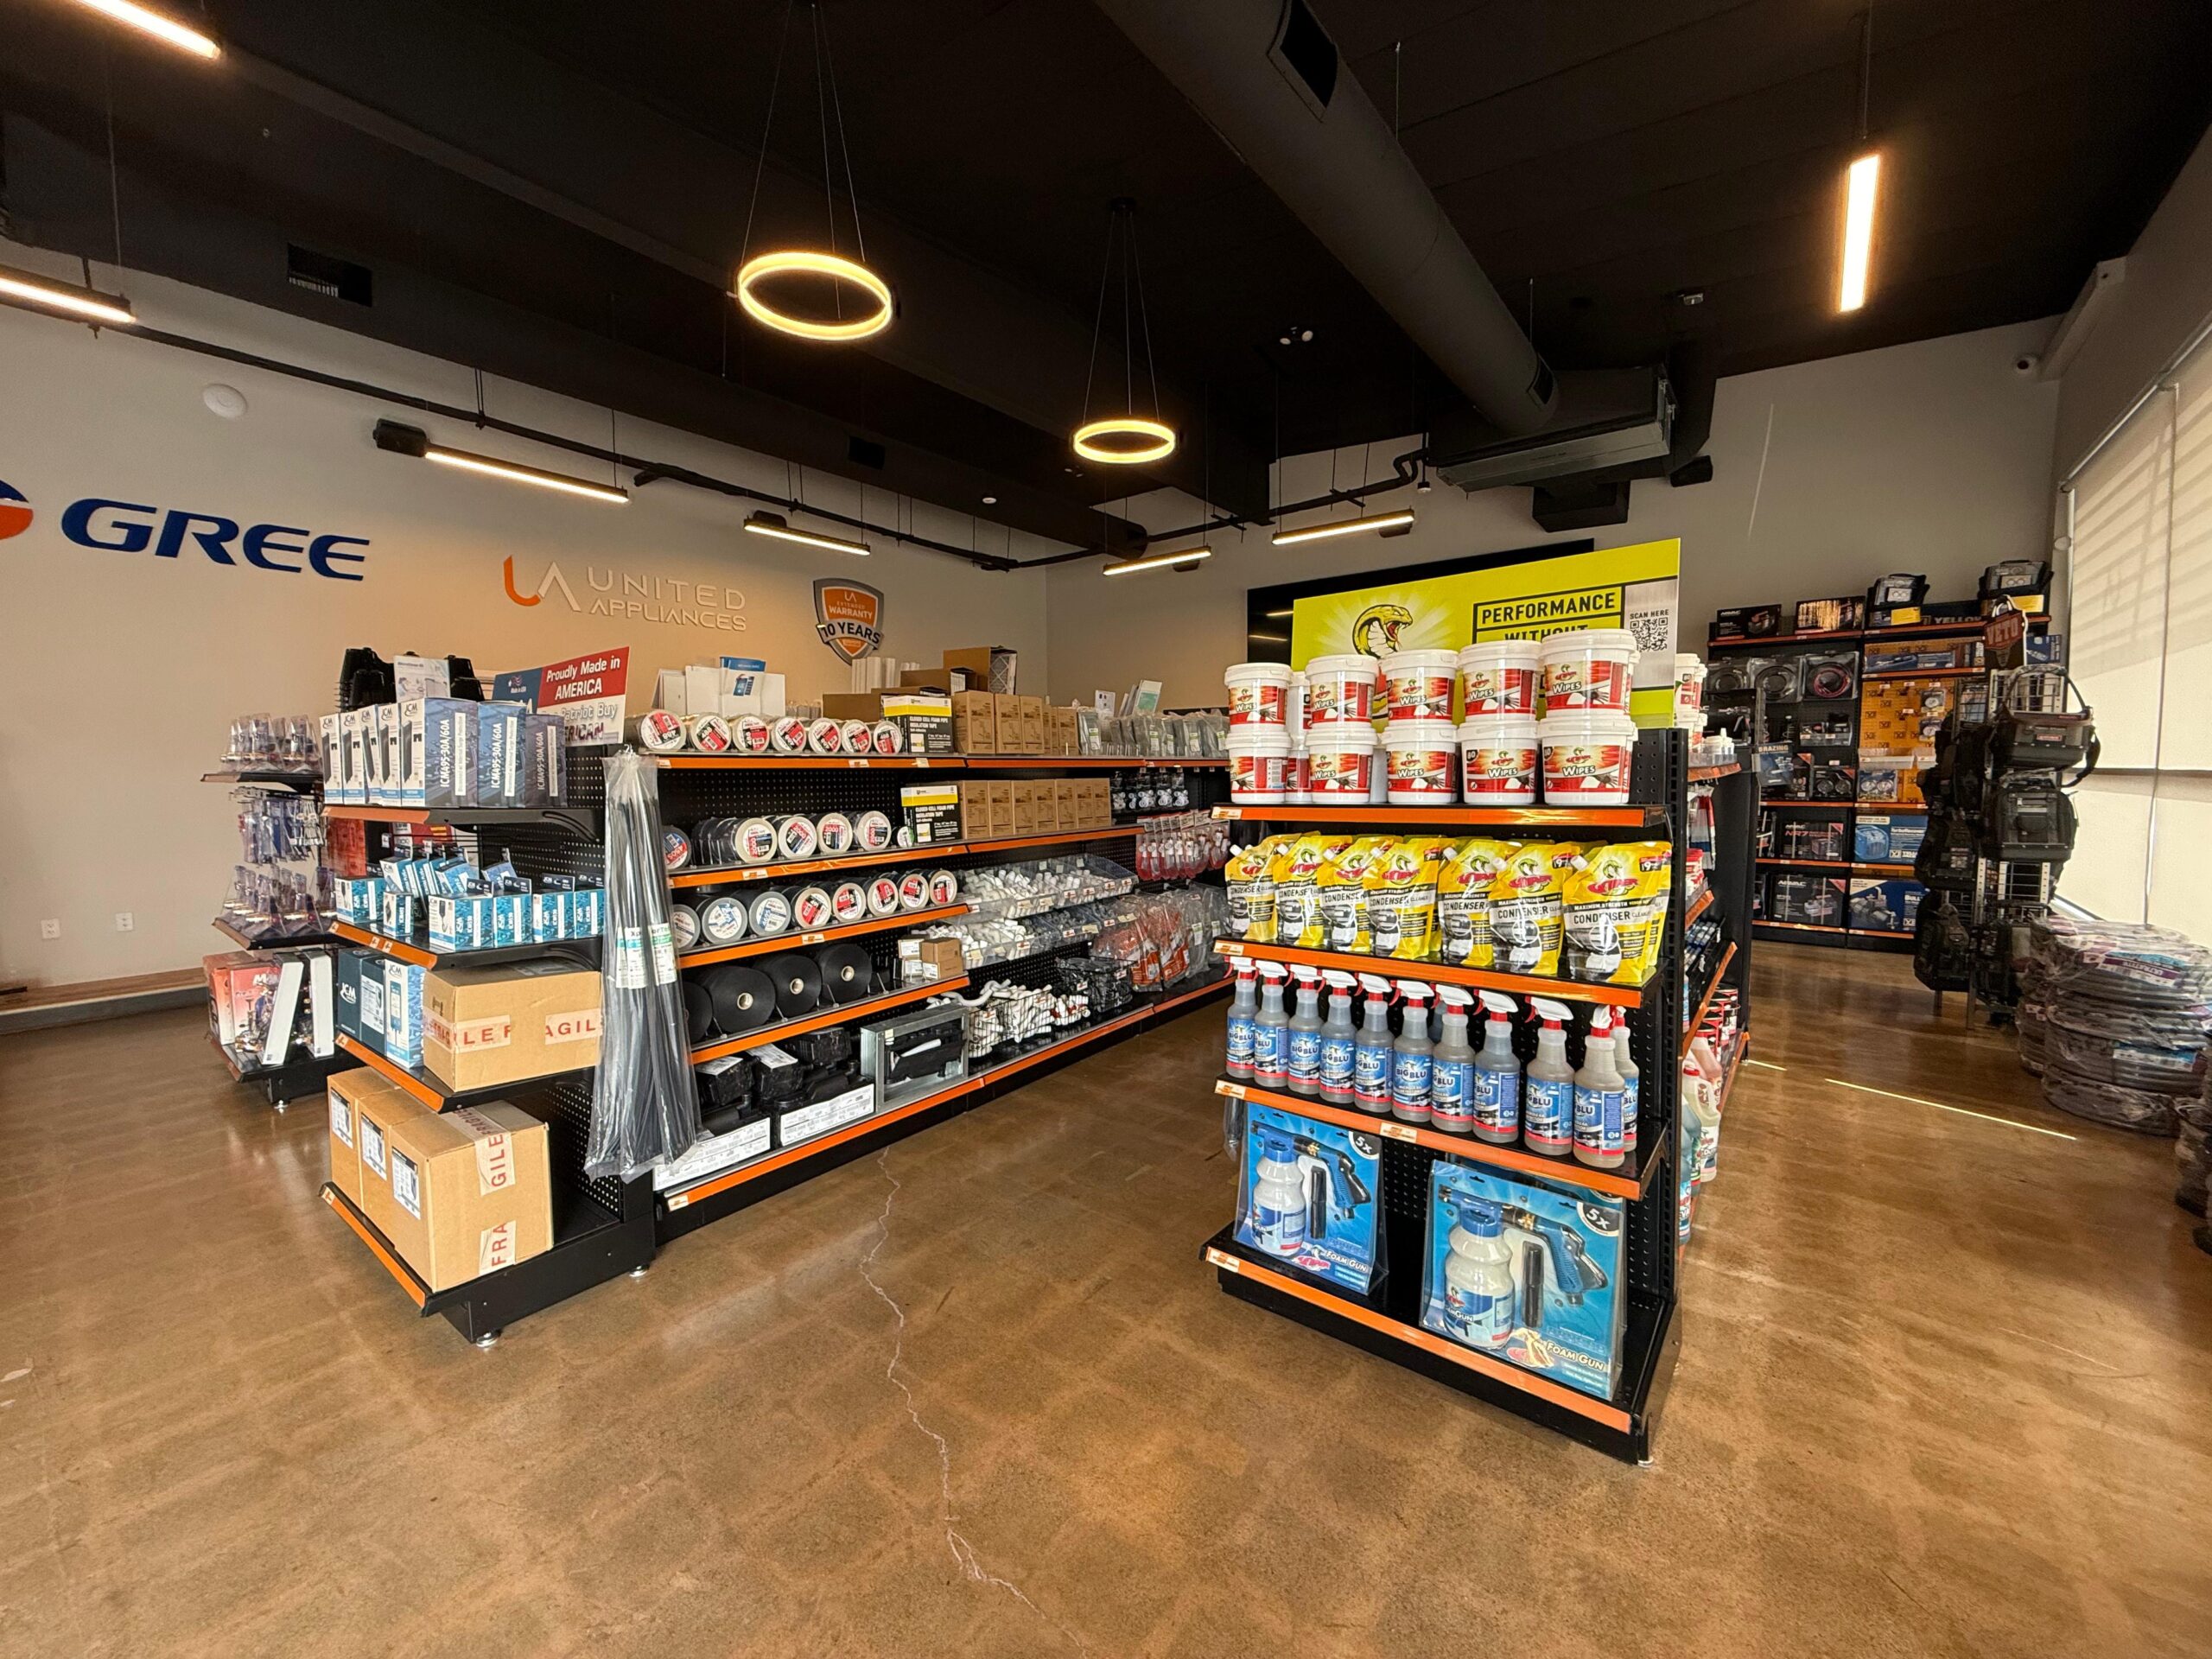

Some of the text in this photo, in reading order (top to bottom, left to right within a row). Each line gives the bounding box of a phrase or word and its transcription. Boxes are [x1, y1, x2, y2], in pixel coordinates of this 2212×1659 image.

[61, 498, 371, 582] GREE
[587, 565, 747, 612] UNITED
[589, 598, 747, 632] APPLIANCES
[829, 606, 873, 620] WARRANTY
[1482, 592, 1616, 625] PERFORMANCE
[1630, 608, 1669, 620] SCAN HERE
[821, 623, 836, 638] 10
[837, 622, 881, 645] YEARS
[1987, 617, 2018, 645] VETO
[546, 655, 620, 683] Proudly Made in
[555, 678, 602, 701] AMERICA
[1468, 688, 1494, 701] WIPES
[1553, 681, 1582, 694] WIPES
[597, 702, 618, 720] Buy
[1313, 699, 1334, 709] WIPES
[1400, 695, 1427, 706] WIPES
[563, 722, 605, 744] ERICAN
[439, 719, 450, 788] ICM495-30A/60A
[490, 722, 502, 789] ICM495-30A/60A
[1313, 769, 1337, 779] WIPES
[1397, 769, 1425, 779] WIPES
[1487, 766, 1518, 779] WIPES
[1562, 766, 1596, 777] WIPES
[1326, 1250, 1368, 1272] FOAM GUN
[1547, 1342, 1605, 1371] FOAM GUN
